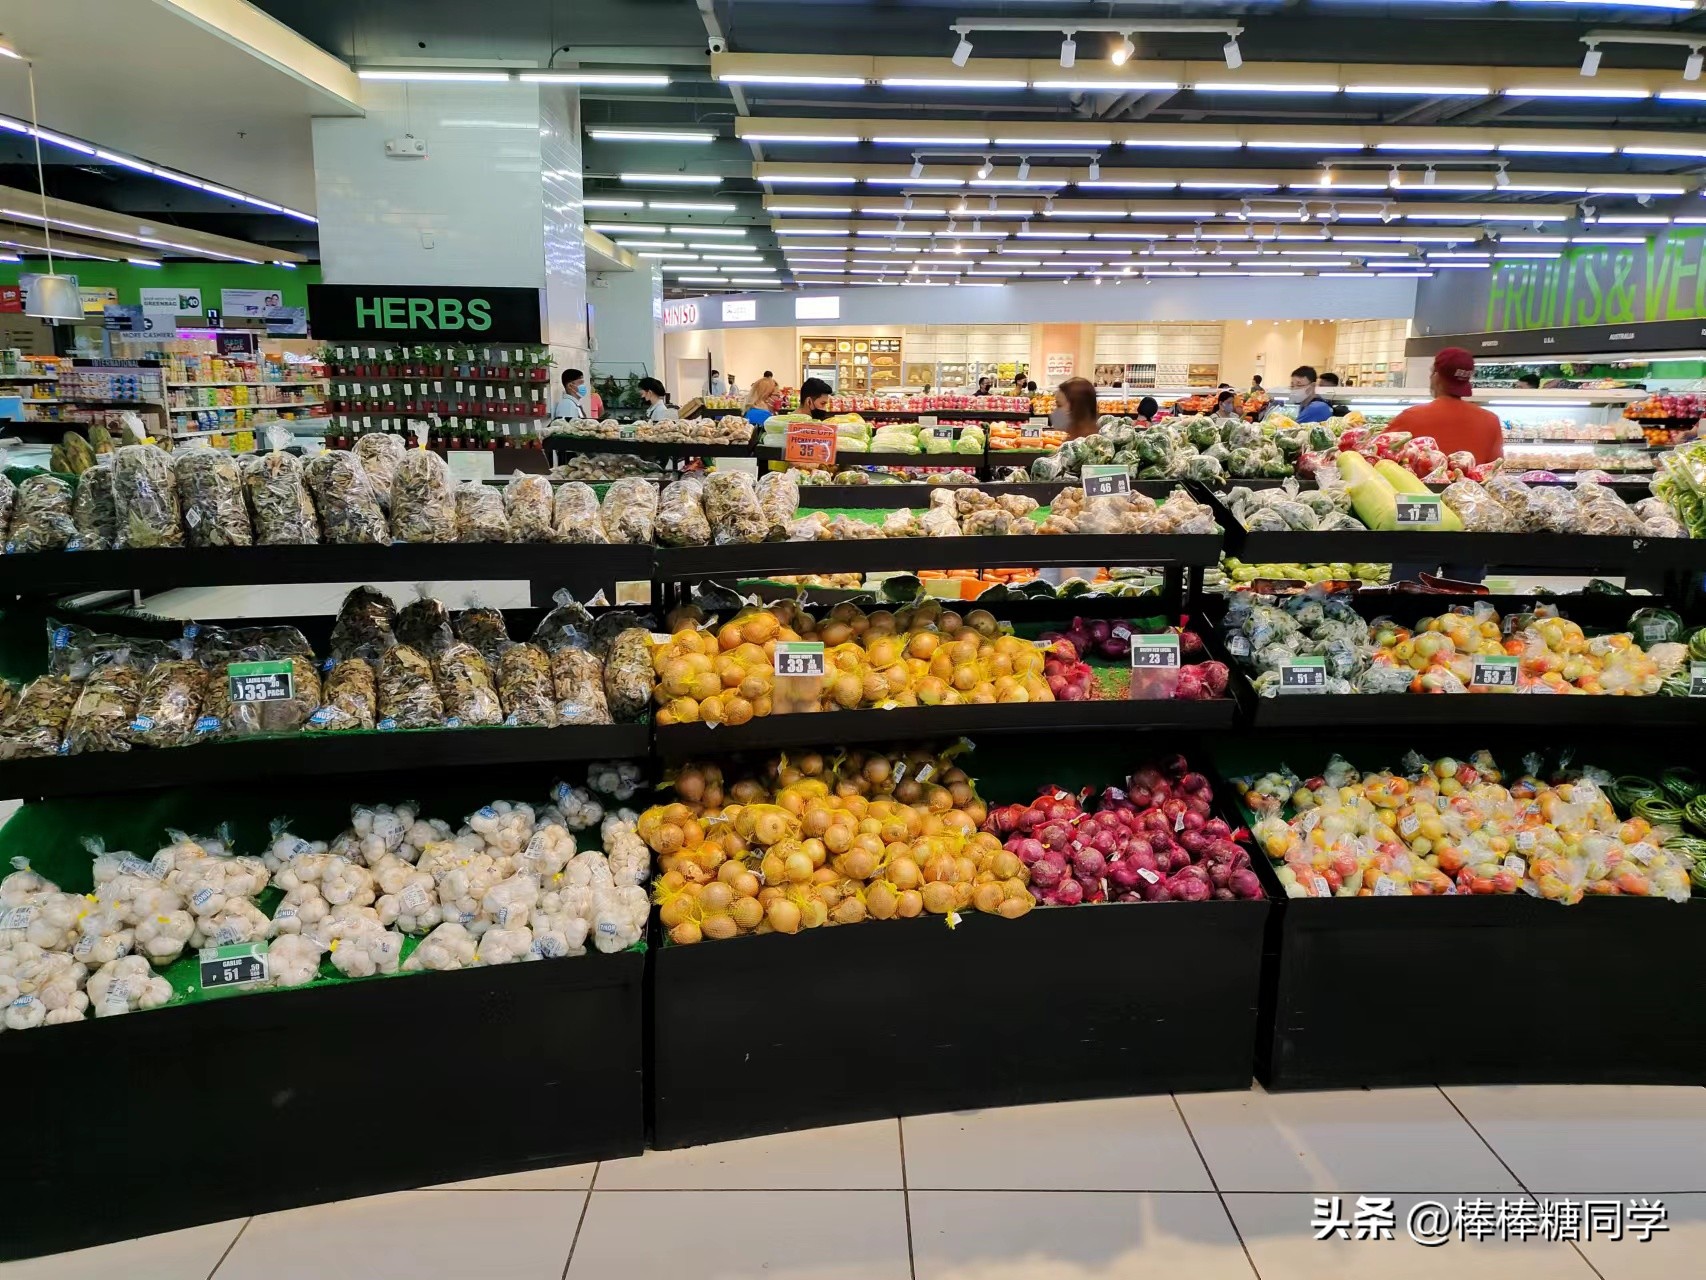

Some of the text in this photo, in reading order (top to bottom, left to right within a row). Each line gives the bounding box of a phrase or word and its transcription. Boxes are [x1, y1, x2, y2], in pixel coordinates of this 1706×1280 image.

[356, 297, 492, 331] HERBS
[664, 304, 696, 325] MINISO
[92, 359, 139, 368] INTERNATIONAL
[800, 445, 814, 457] 35
[1100, 483, 1112, 492] 46
[1408, 508, 1420, 520] 17
[1149, 653, 1160, 664] 23
[787, 658, 803, 672] 33
[1297, 673, 1308, 684] 51
[1483, 671, 1500, 683] 53
[267, 689, 285, 697] PACK
[222, 959, 242, 967] GARLIC
[223, 967, 239, 981] 51
